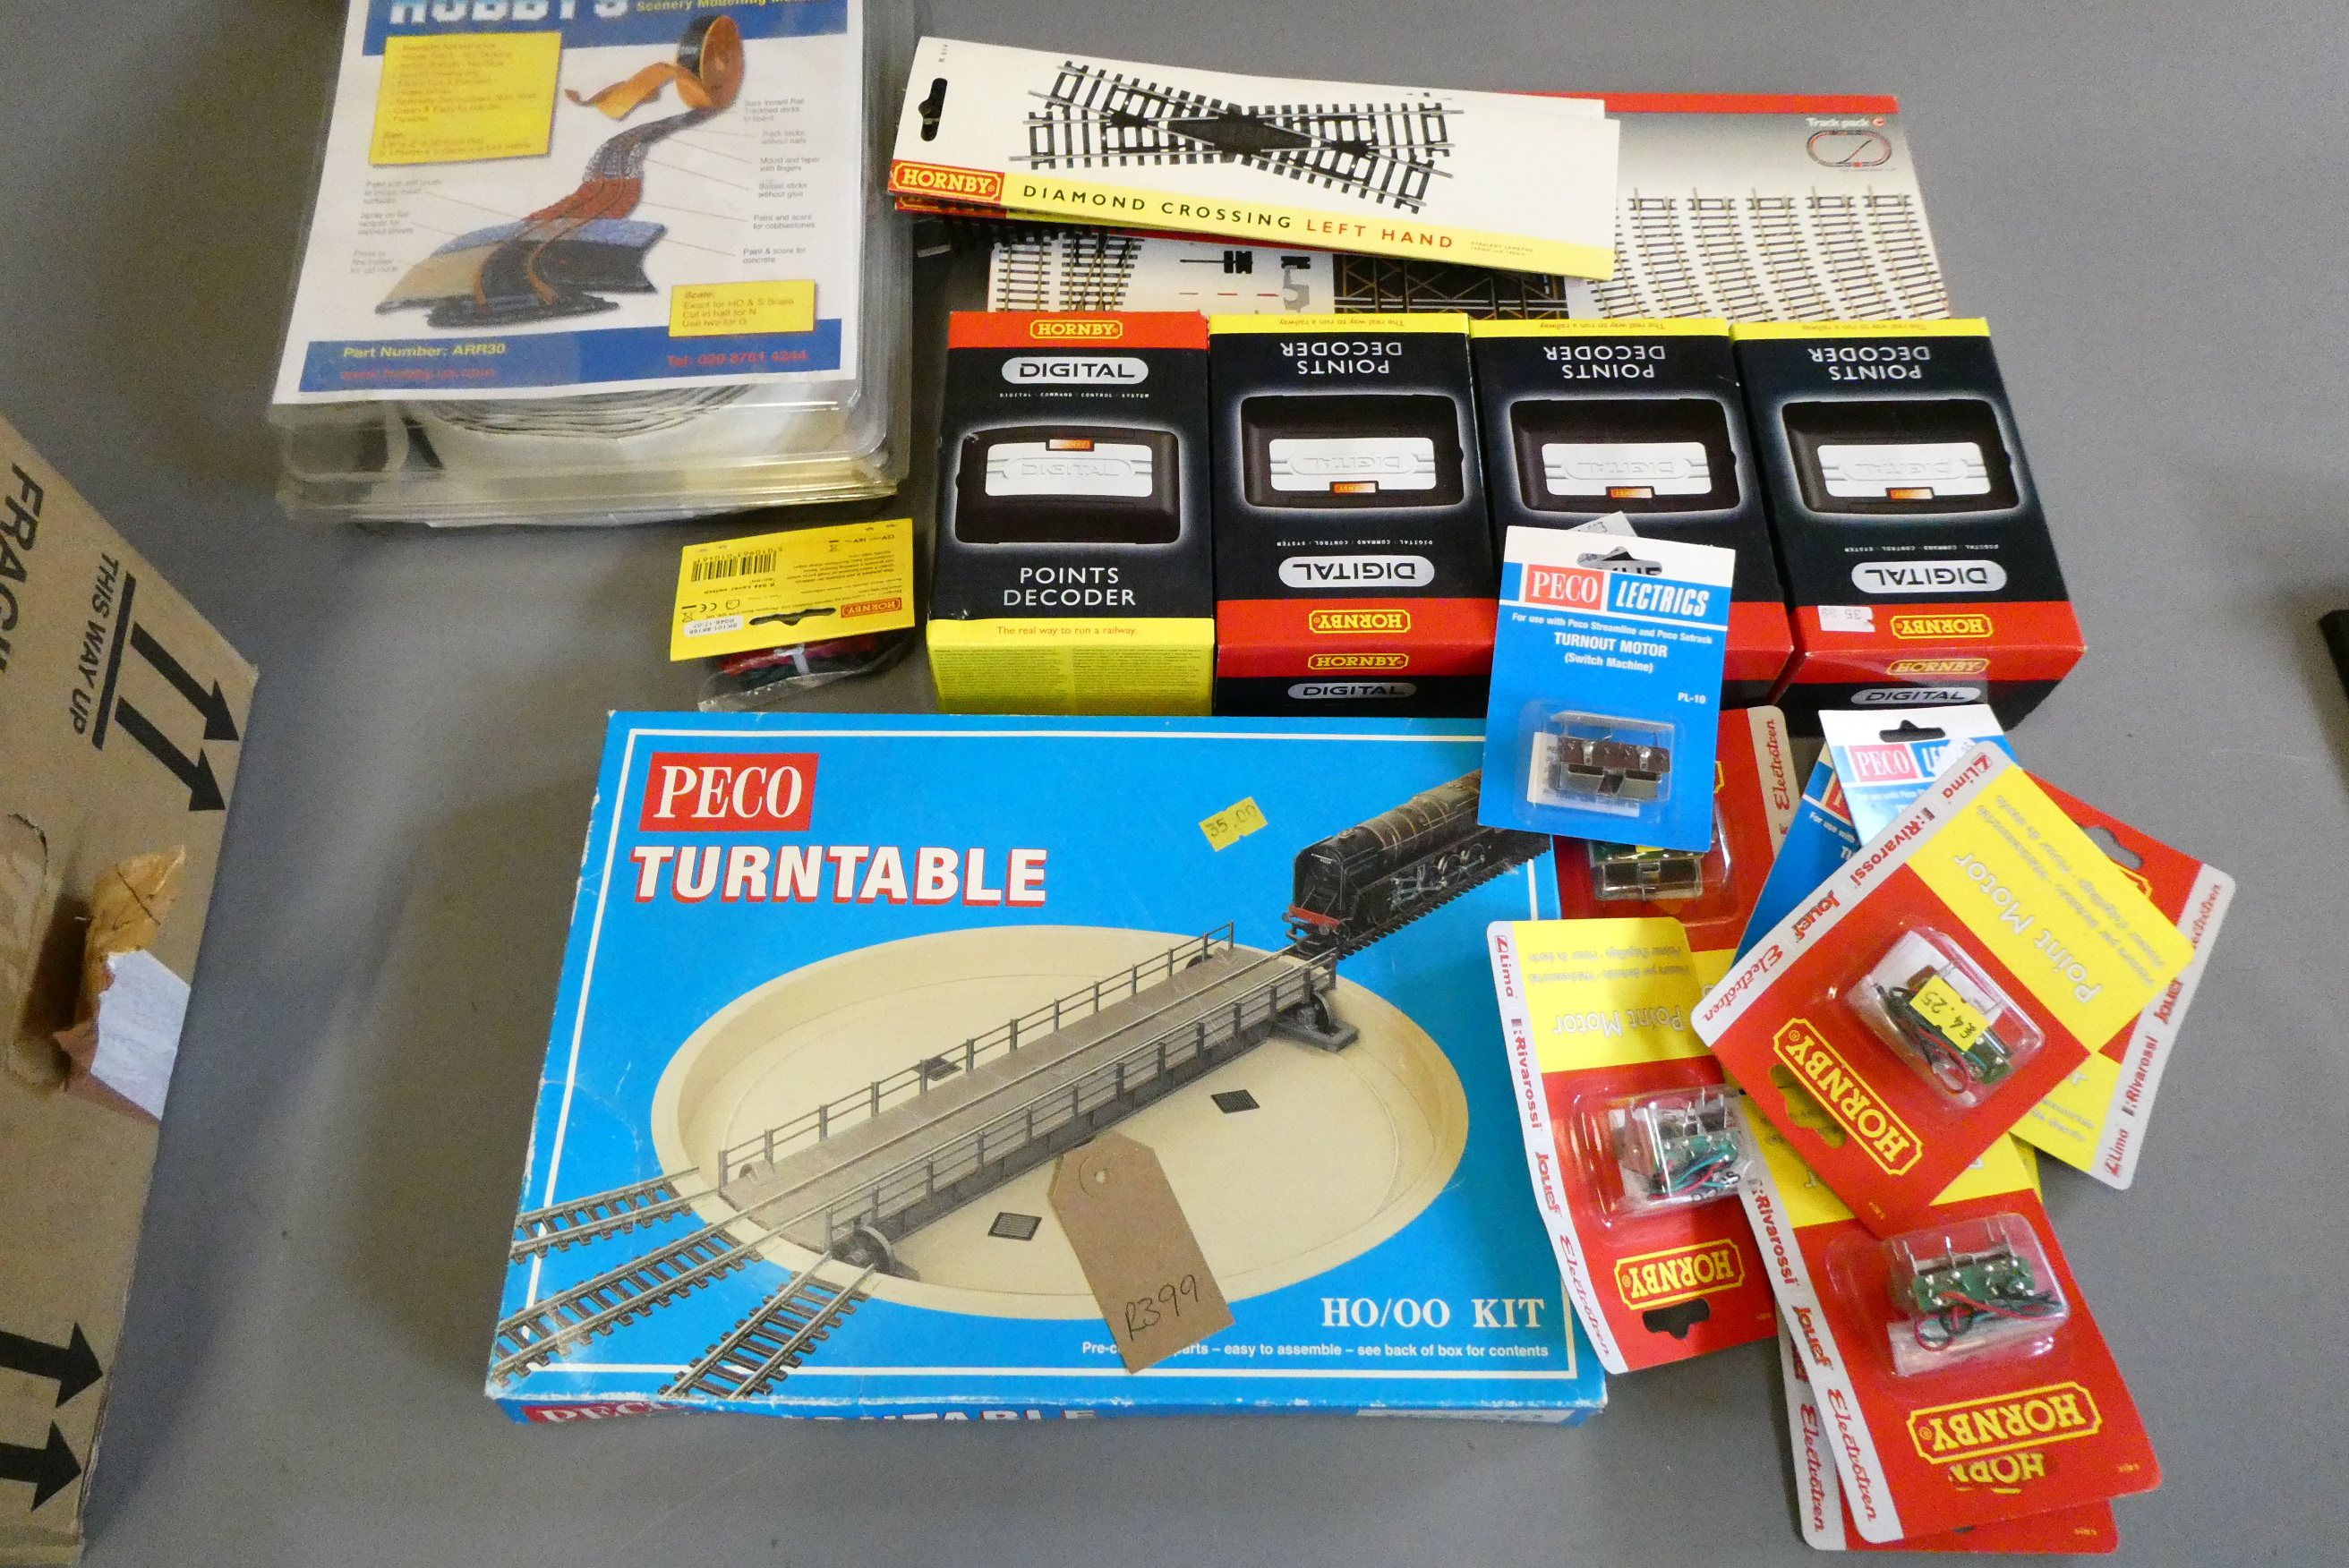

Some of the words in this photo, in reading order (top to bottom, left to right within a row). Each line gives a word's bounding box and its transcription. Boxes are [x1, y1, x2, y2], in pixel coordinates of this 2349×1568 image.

[903, 168, 992, 193] HORNBY
[1023, 185, 1145, 210] DIAMOND
[1162, 202, 1291, 229] CROSSING
[1307, 219, 1366, 237] LEFT
[1382, 228, 1453, 248] HAND
[1038, 324, 1115, 335] HORNBY
[344, 347, 375, 357] Part
[380, 346, 446, 357] Number:
[453, 343, 506, 356] ARR30
[1280, 342, 1402, 356] DECODER
[1543, 346, 1665, 360] DECODER
[1807, 346, 1931, 362] DECODER
[1020, 363, 1135, 378] DIGITAL
[1297, 360, 1389, 374] POINTS
[1562, 364, 1654, 379] POINTS
[1828, 364, 1922, 380] POINTS
[1022, 464, 1118, 476] DIGITAL
[92, 553, 119, 618] THIS
[1021, 567, 1118, 584] POINTS
[1293, 563, 1415, 580] DIGITAL
[1865, 567, 1987, 585] DIGITAL
[846, 600, 896, 615] HORNBY
[1004, 590, 1136, 606] DECODER
[1531, 570, 1598, 603] PECO
[1616, 581, 1711, 617] LECTRICS
[997, 626, 1015, 635] The
[1019, 626, 1036, 635] real
[1103, 626, 1137, 635] railway.
[1319, 614, 1402, 628] HORNBY
[1512, 613, 1526, 622] For
[1529, 616, 1543, 624] use
[1547, 617, 1566, 626] with
[1568, 618, 1588, 629] Peco
[1591, 621, 1636, 635] Streamline
[1639, 627, 1655, 637] and
[1657, 629, 1678, 640] Peco
[1680, 633, 1713, 644] Setrack
[1901, 619, 1985, 634] HORNBY
[79, 619, 106, 688] WAY
[1554, 632, 1616, 651] TURNOUT
[1619, 641, 1668, 658] MOTOR
[1316, 656, 1400, 667] HORNBY
[1565, 652, 1603, 666] (Switch
[1607, 658, 1653, 673] Machine)
[1896, 662, 1980, 671] HORNBY
[1303, 686, 1404, 695] DIGITAL
[1678, 693, 1706, 703] PL-10
[1866, 692, 1966, 701] DIGITAL
[70, 688, 91, 734] UP
[1766, 719, 1790, 810] Electrotren
[1854, 750, 1910, 776] PECO
[653, 765, 803, 819] PECO
[1942, 766, 1979, 798] Lima
[1810, 812, 1823, 822] For
[1850, 816, 1924, 889] Rivarossi
[629, 846, 1047, 908] TURNTABLE
[1953, 853, 2037, 936] Motor
[1790, 891, 1841, 944] Jouef
[1498, 954, 1515, 998] Lima
[2033, 928, 2103, 1006] Point
[1702, 943, 1784, 1021] Electrotren
[1553, 1011, 1623, 1037] Motor
[1627, 1005, 1685, 1032] Point
[1512, 1036, 1542, 1129] Rivarossi
[2124, 1035, 2158, 1102] Rivarossi
[1785, 1035, 1910, 1163] HORNBY
[2107, 1129, 2129, 1163] Lima
[1535, 1151, 1562, 1219] Jouef
[1757, 1199, 1795, 1285] Rivarossi
[1629, 1250, 1735, 1300] HORNBY
[1123, 1274, 1200, 1342] R399
[1559, 1234, 1609, 1357] Electrotren
[1320, 1296, 1450, 1328] HO/OO
[1472, 1296, 1545, 1328] KIT
[1224, 1344, 1254, 1358] easy
[1260, 1344, 1273, 1354] to
[1277, 1343, 1342, 1356] assemble
[1358, 1346, 1380, 1356] see
[1385, 1344, 1417, 1356] back
[1421, 1344, 1434, 1356] of
[1438, 1344, 1462, 1356] box
[1466, 1344, 1485, 1356] for
[1489, 1345, 1549, 1356] contents
[1793, 1307, 1834, 1370] Jouef
[1931, 1392, 2086, 1453] HORNBY
[1800, 1403, 1825, 1531] Electrotren
[1827, 1388, 1876, 1521] Electrotren
